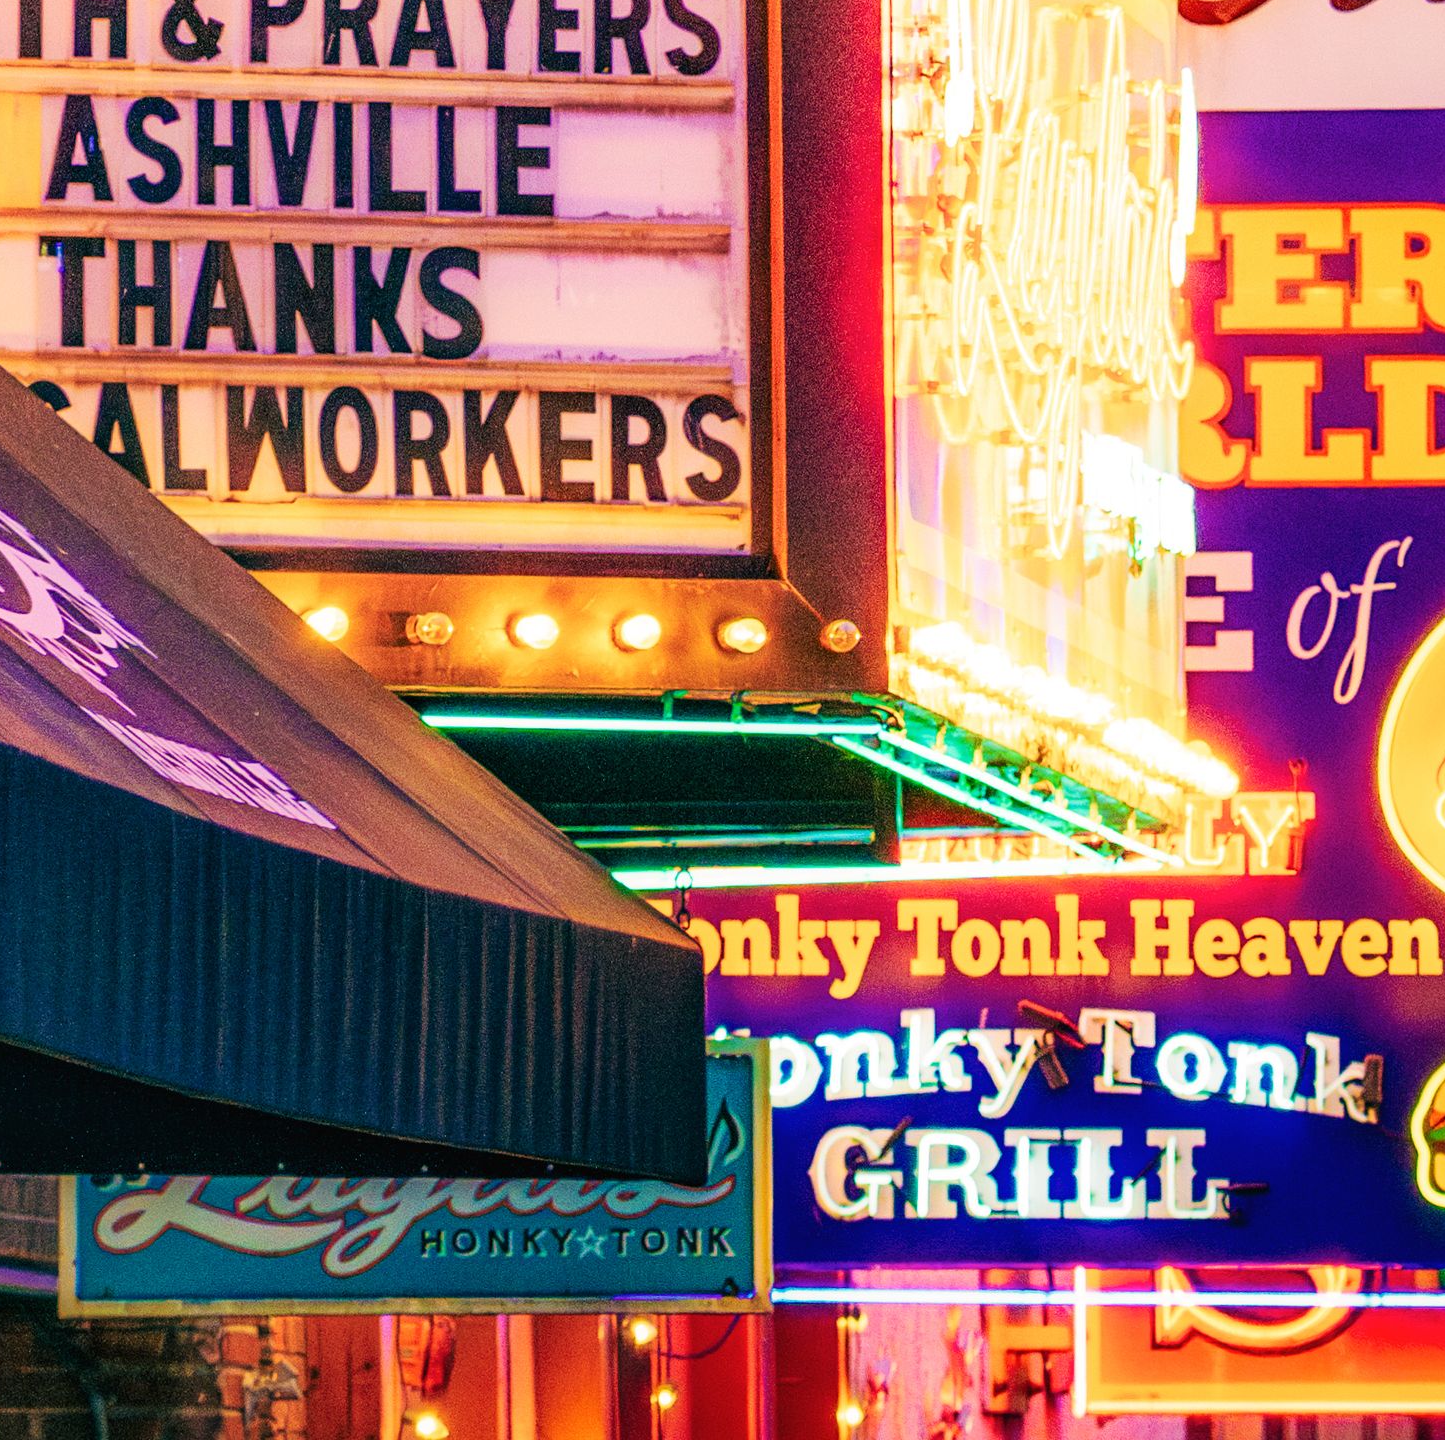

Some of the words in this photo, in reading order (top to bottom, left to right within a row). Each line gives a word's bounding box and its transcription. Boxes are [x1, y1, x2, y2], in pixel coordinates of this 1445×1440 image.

[44, 95, 556, 217] ASHVILLE
[38, 235, 485, 360] THANKS
[897, 895, 1108, 978] Tonk
[1130, 898, 1443, 978] Heaven
[1080, 1008, 1382, 1124] Tonk
[808, 1127, 1232, 1221] GRILL
[420, 1227, 574, 1258] HONKY
[617, 1227, 736, 1258] TONK
